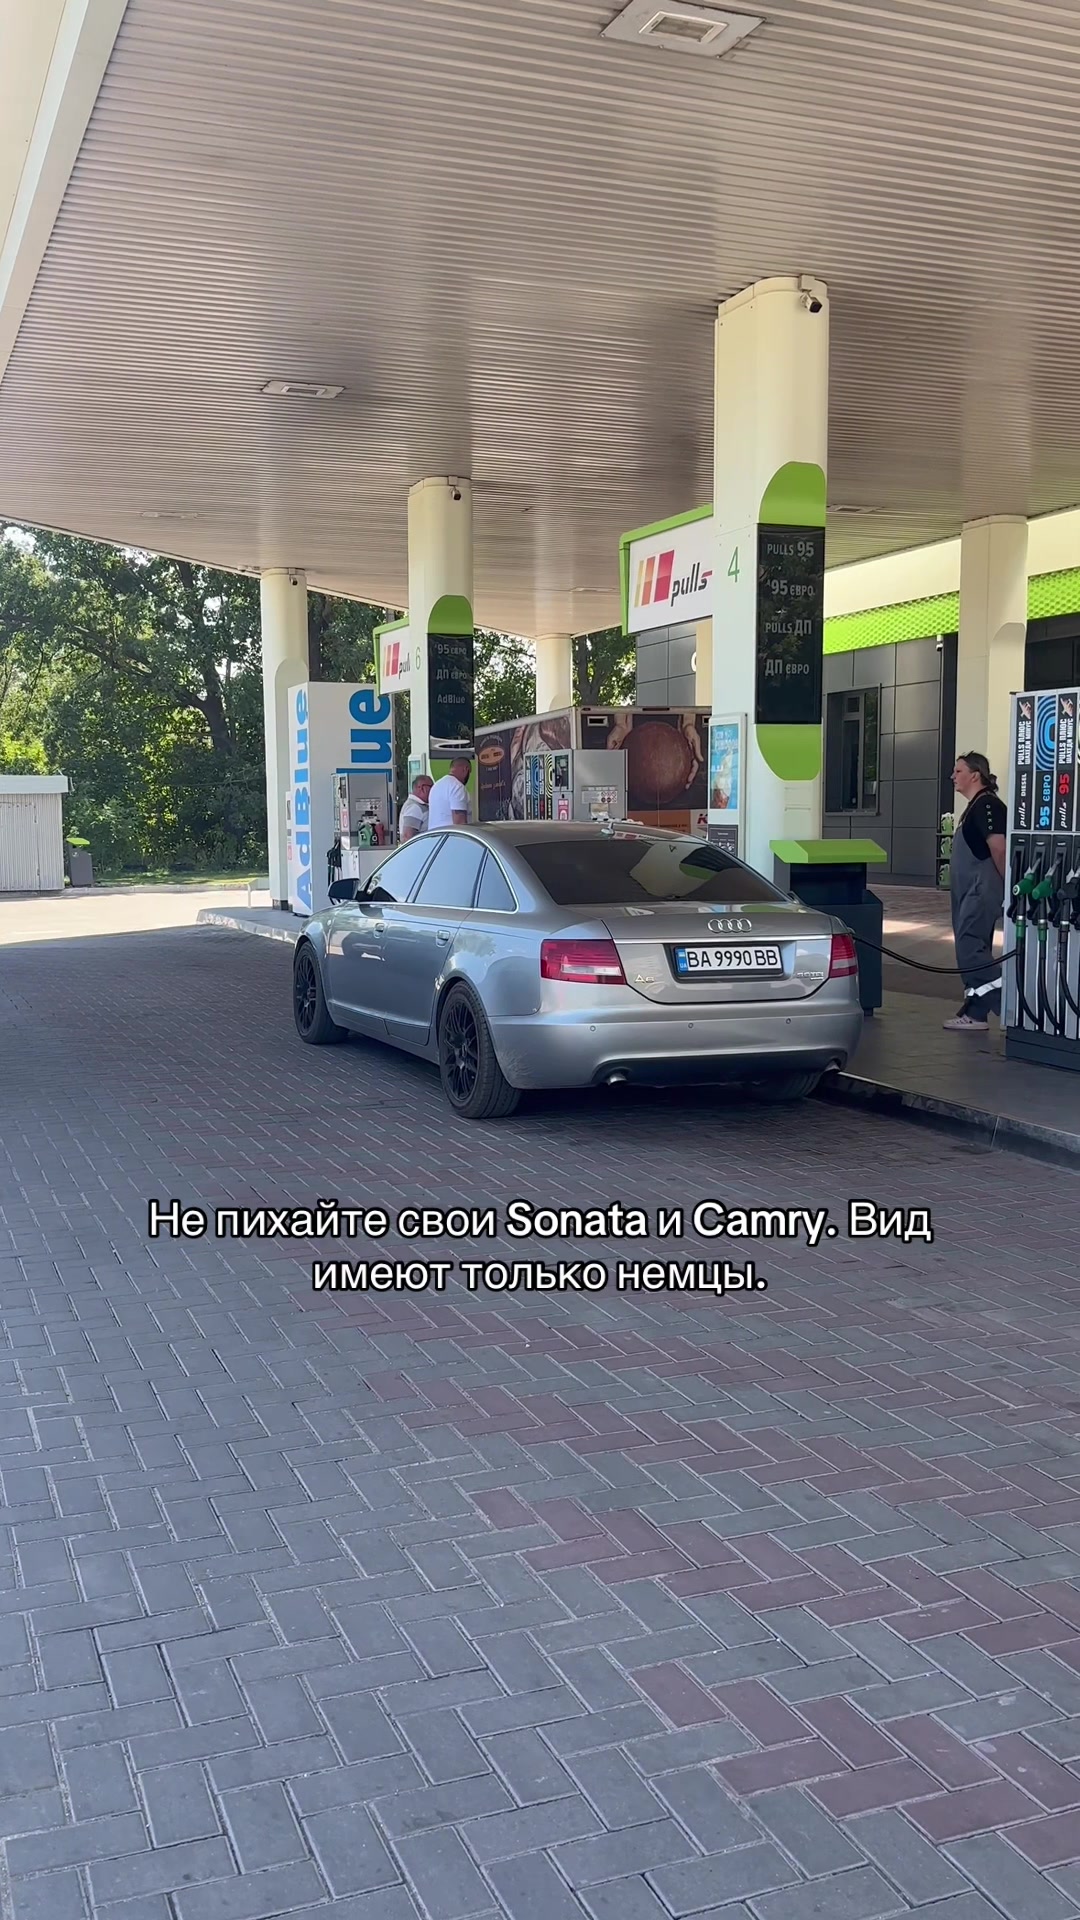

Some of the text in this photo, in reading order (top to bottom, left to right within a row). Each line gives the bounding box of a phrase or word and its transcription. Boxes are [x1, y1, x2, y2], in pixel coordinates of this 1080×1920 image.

[767, 541, 814, 557] PULLS 95
[727, 546, 740, 583] 4
[671, 562, 713, 607] pulls
[789, 585, 814, 596] ЄВРО
[765, 620, 812, 637] PULLS ДП
[398, 652, 411, 680] pull
[415, 646, 421, 670] 6
[764, 659, 810, 677] ДП ЄВРО
[436, 668, 449, 681] ДП
[437, 694, 466, 704] AdBlue
[1017, 744, 1026, 765] PULLS
[1058, 742, 1067, 764] PULLS
[1042, 774, 1051, 802] ЄВРО
[1058, 773, 1070, 795] 95
[294, 688, 312, 911] AdBlue
[686, 949, 778, 968] BA 9990 BB
[634, 974, 655, 983] A6
